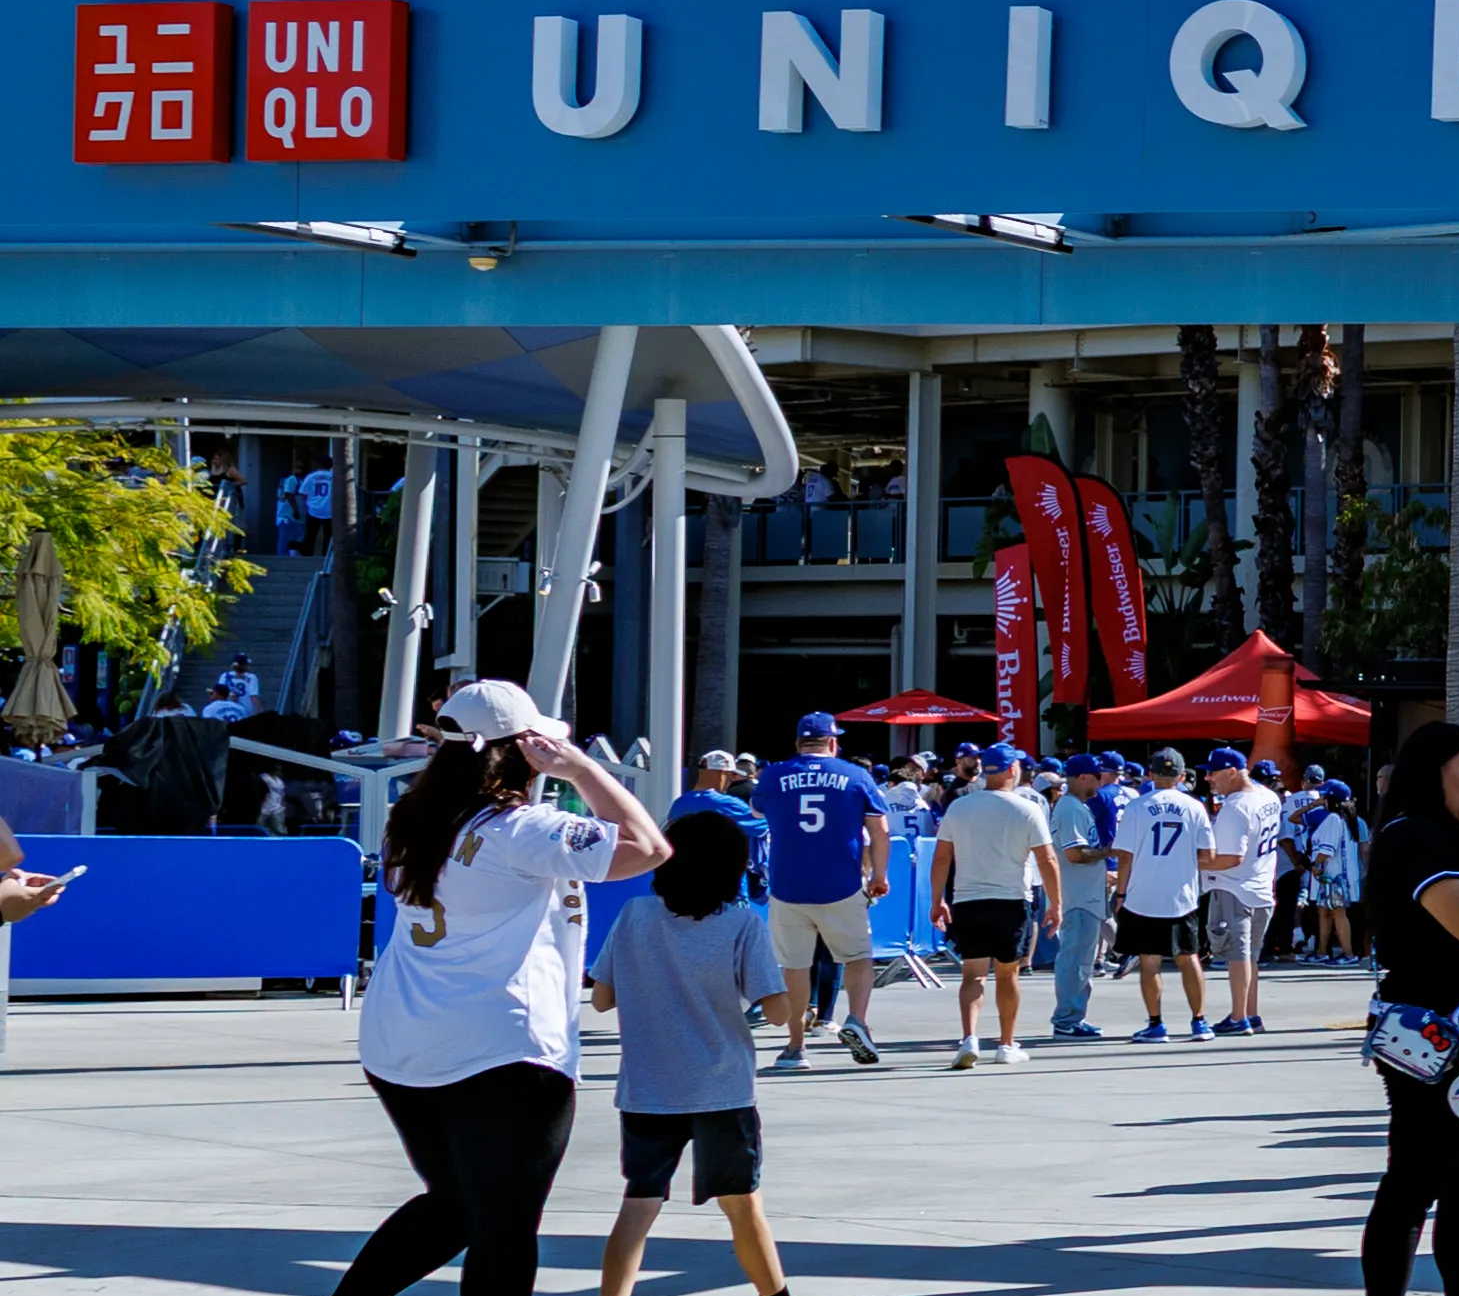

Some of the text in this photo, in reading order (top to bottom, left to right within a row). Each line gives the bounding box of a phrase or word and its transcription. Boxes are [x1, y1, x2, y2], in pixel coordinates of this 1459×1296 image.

[265, 20, 364, 73] UNI
[264, 86, 373, 149] QLO
[1105, 544, 1142, 644] Budweiser
[780, 772, 850, 793] FREEMAN
[799, 794, 826, 833] 5
[1151, 820, 1183, 856] 17
